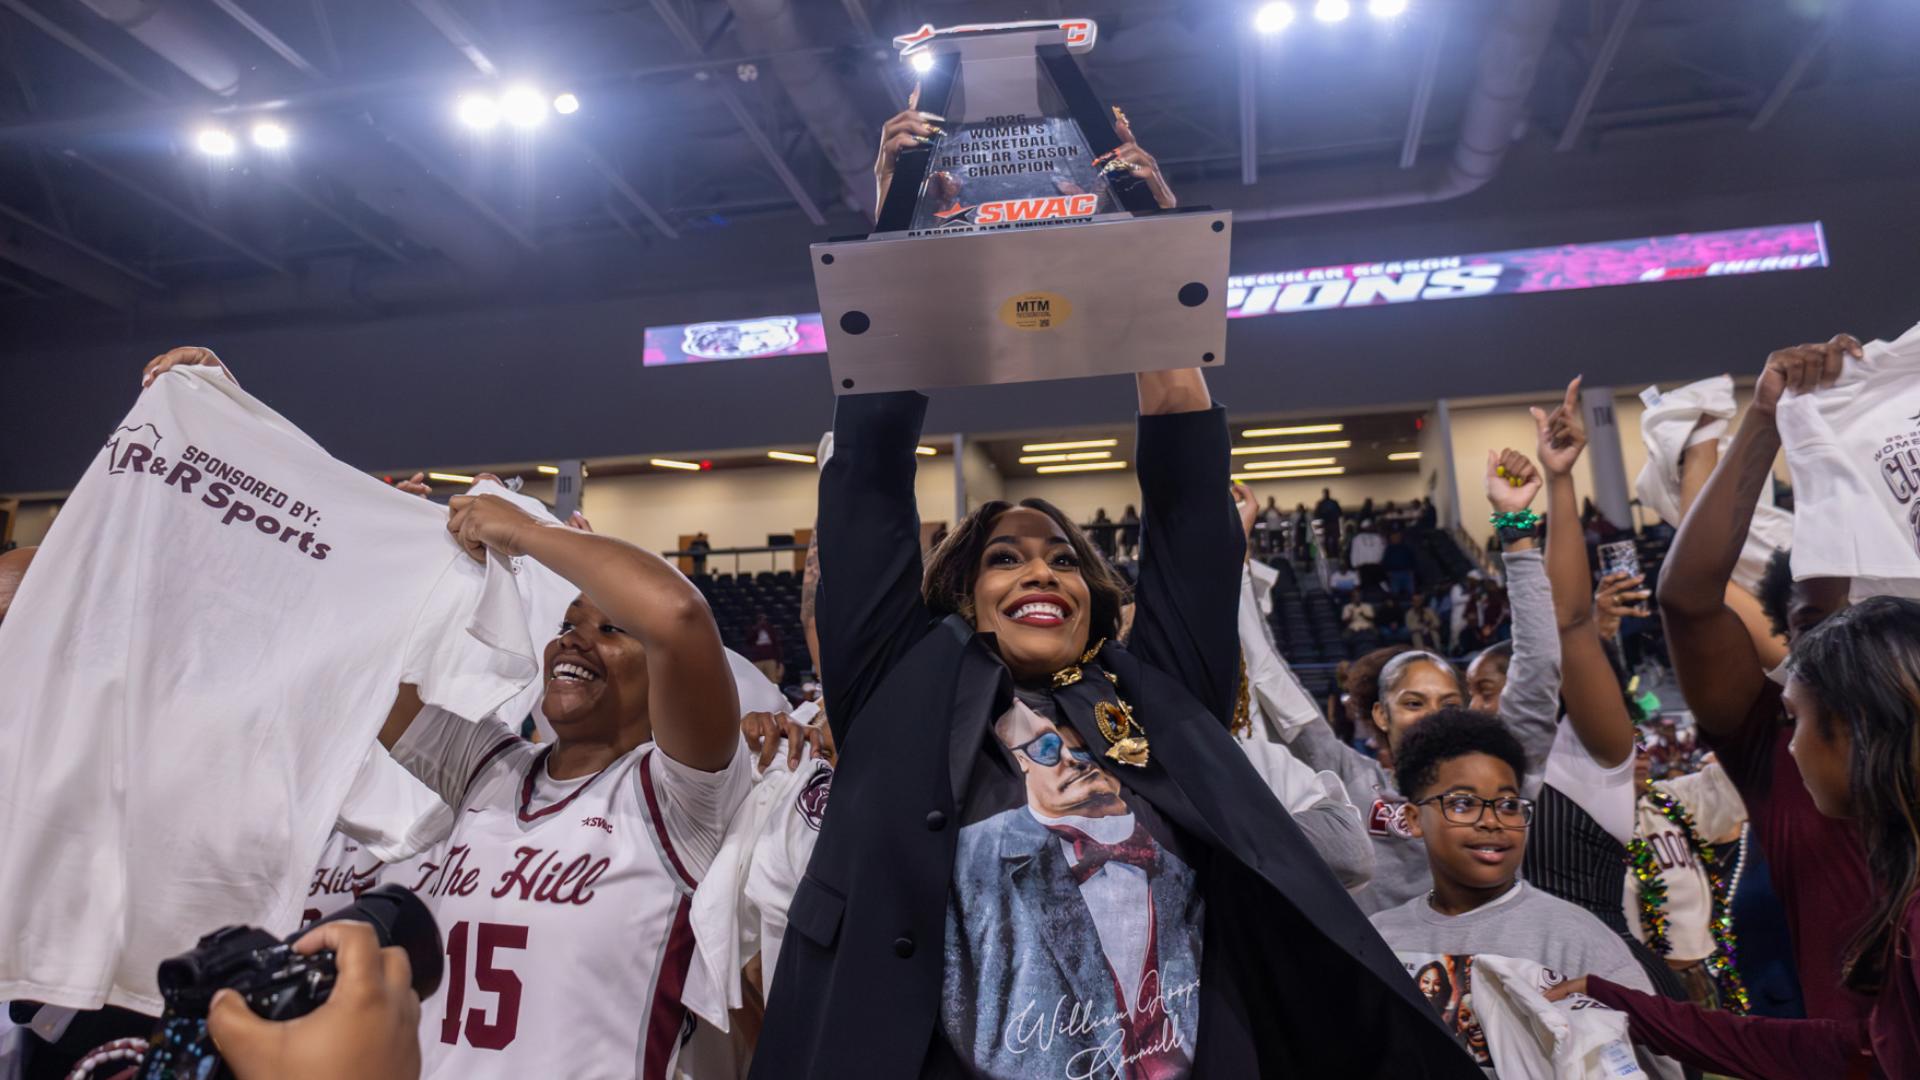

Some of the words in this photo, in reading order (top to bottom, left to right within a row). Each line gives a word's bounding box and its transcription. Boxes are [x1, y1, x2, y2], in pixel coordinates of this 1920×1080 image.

[960, 136, 1055, 153] BASKETBALL
[969, 125, 1045, 139] WOMEN'S
[941, 151, 1011, 167] REGULAR
[1017, 146, 1078, 161] SEASON
[968, 161, 1054, 177] CHAMPION
[976, 194, 1098, 224] SWAC
[1016, 301, 1049, 312] MTM
[117, 442, 202, 494] R&R
[201, 482, 331, 560] Sports
[182, 445, 288, 509] SPONSORED
[289, 500, 321, 527] BY:
[308, 866, 357, 897] Hil
[409, 844, 481, 898] The
[491, 846, 611, 905] Hill
[440, 920, 529, 1051] 15
[1004, 994, 1129, 1054] William
